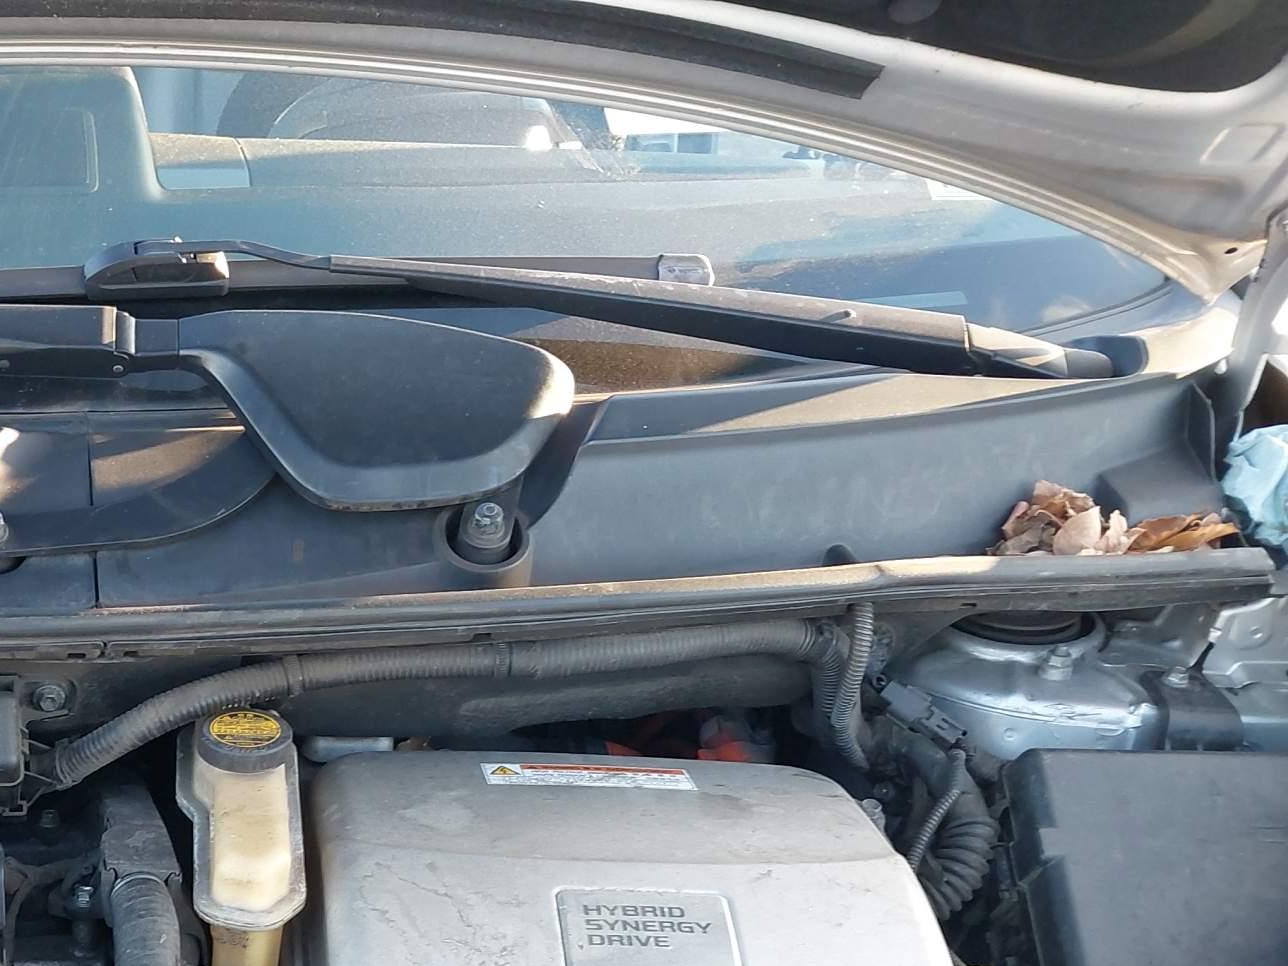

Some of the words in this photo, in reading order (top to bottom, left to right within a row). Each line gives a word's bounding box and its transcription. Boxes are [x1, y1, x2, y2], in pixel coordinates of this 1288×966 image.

[582, 904, 686, 918] HYBRID
[584, 918, 712, 934] SYNERGY
[587, 934, 671, 947] DRIVE
